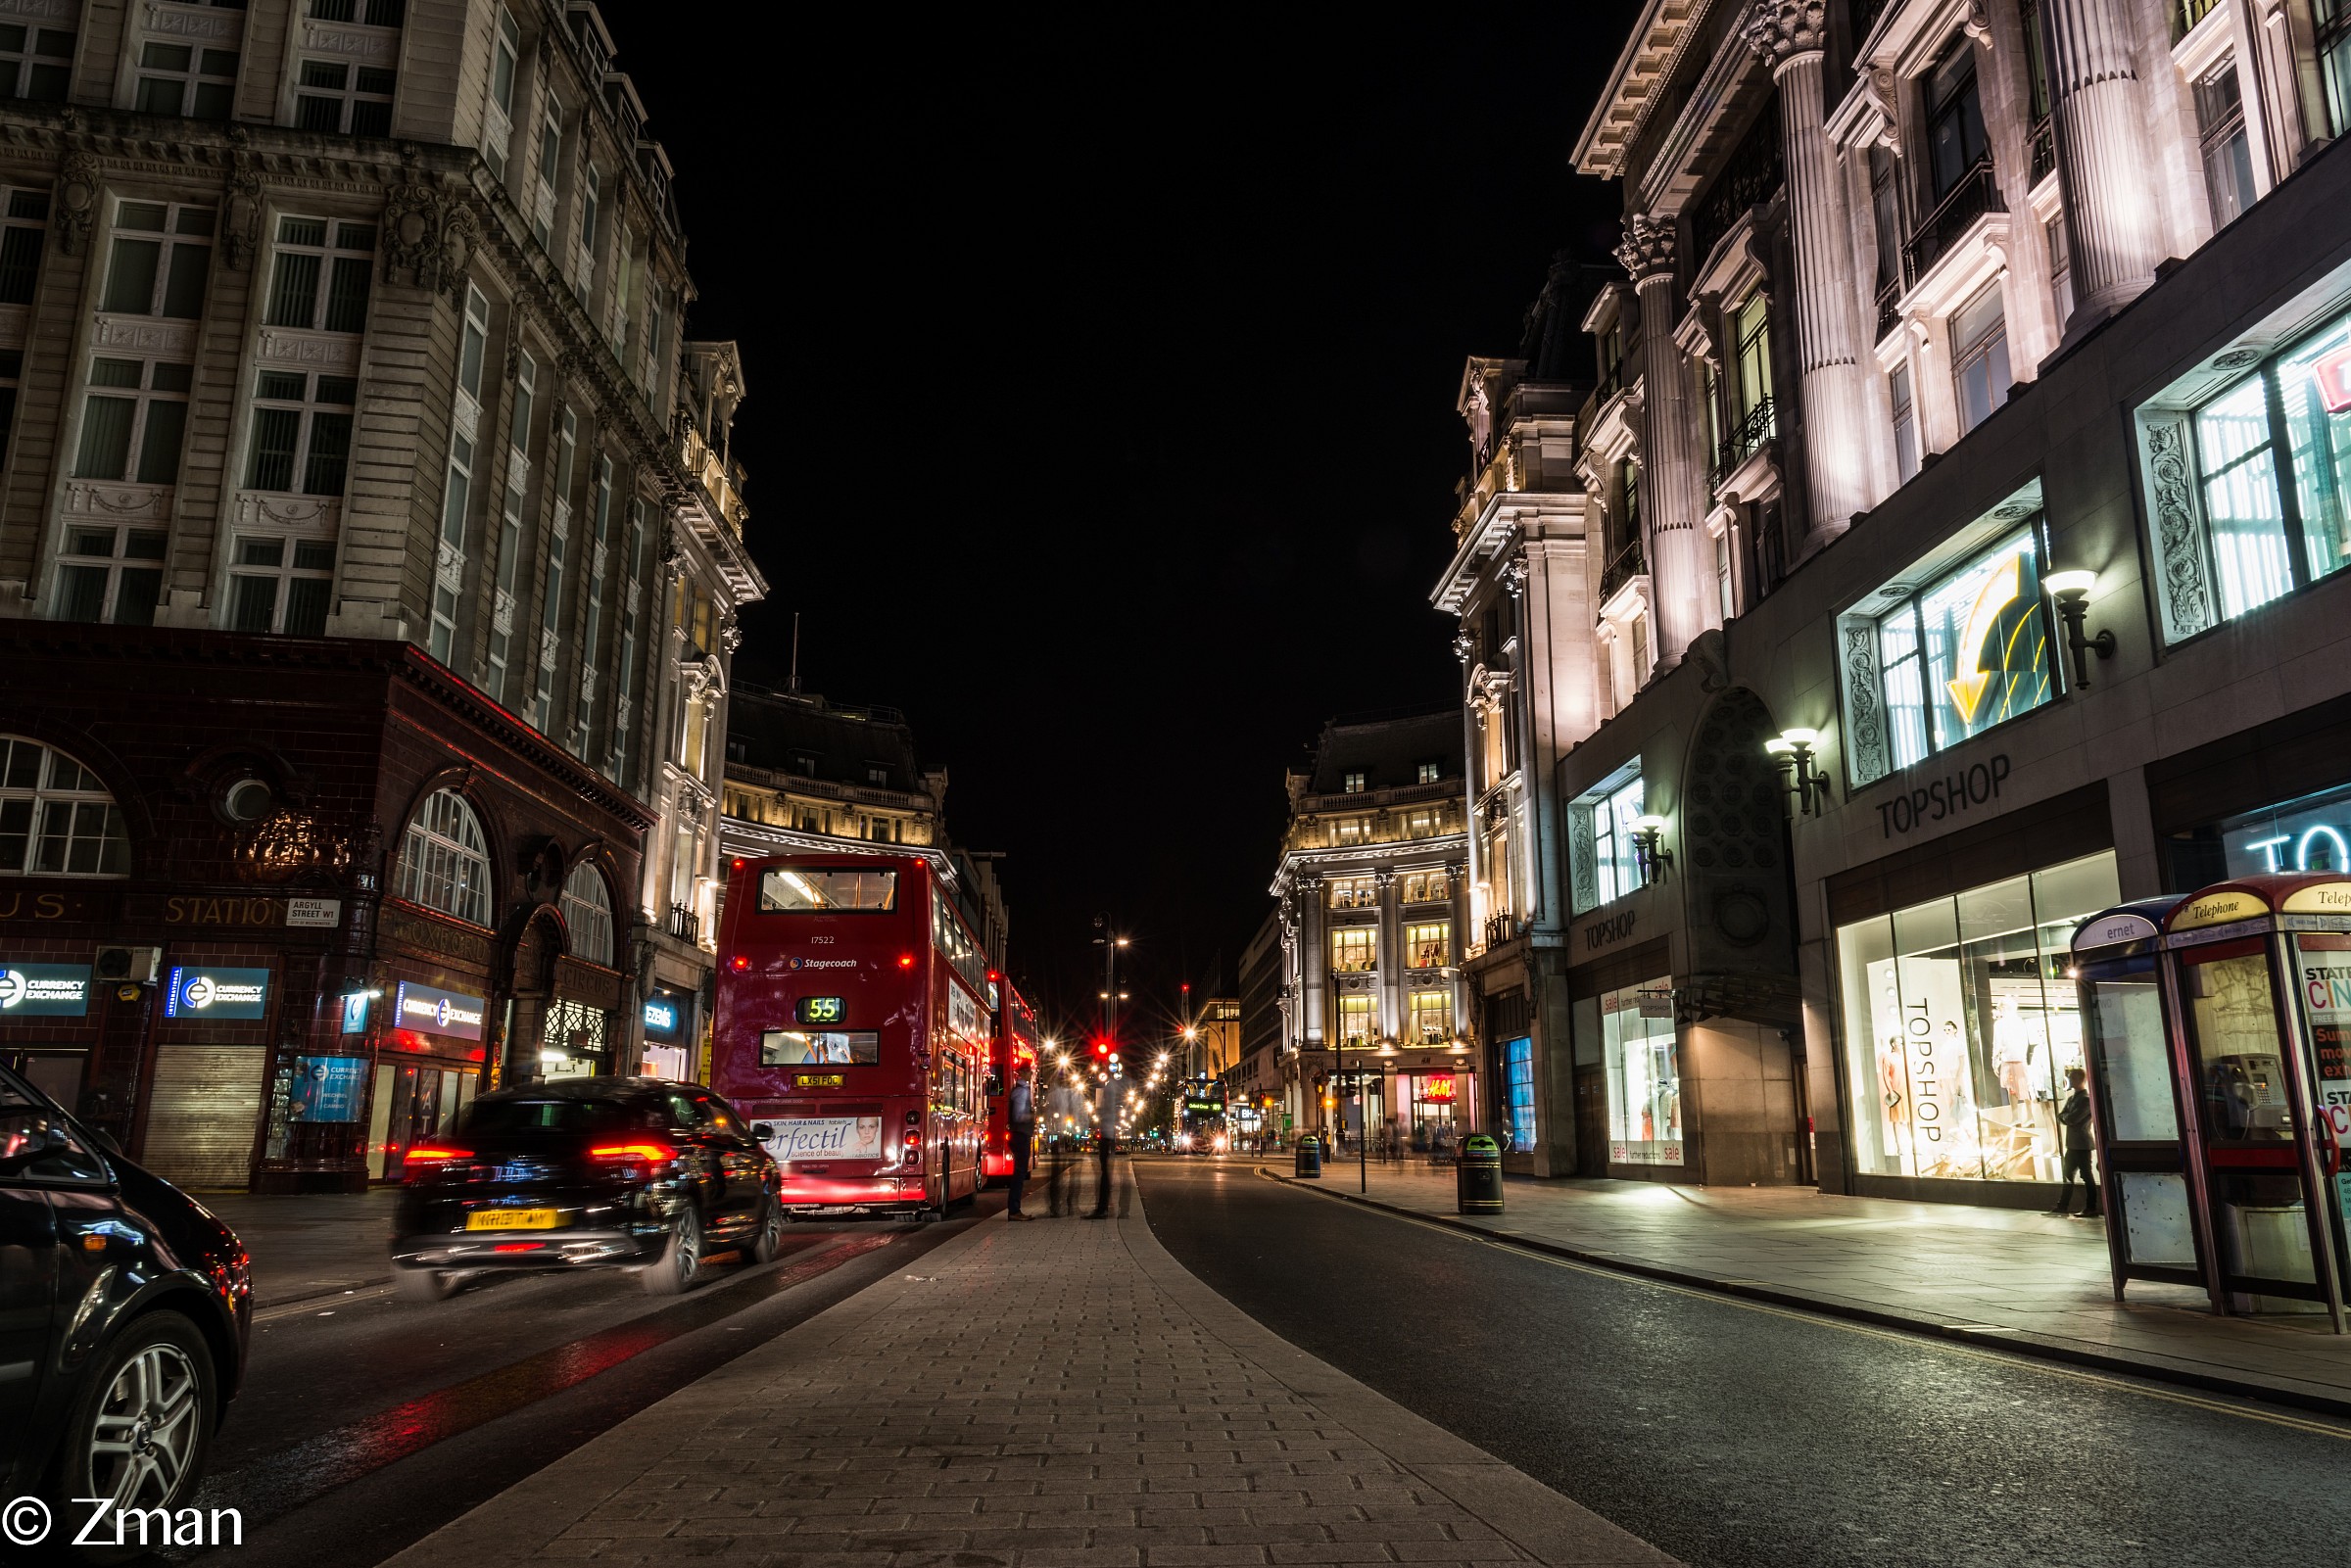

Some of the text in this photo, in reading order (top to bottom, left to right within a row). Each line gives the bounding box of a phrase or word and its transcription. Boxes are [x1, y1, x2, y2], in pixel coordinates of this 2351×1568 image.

[1875, 753, 2010, 838] TOPSHOP
[293, 901, 323, 910] ARGYLL
[2193, 900, 2239, 920] Telephone
[1584, 909, 1635, 951] TOPSHOP
[2107, 923, 2135, 939] ernet
[411, 921, 486, 960] OXFORD
[804, 959, 857, 970] Stagecoach
[27, 980, 85, 990] CURRENCY
[216, 985, 264, 994] CURRENCY
[563, 968, 611, 995] CIRCUS
[25, 990, 84, 1000] EXCHANGE
[215, 993, 262, 1002] EXCHANGE
[1605, 995, 1617, 1011] sale
[403, 999, 481, 1024] CURRENCY EXCHANGE
[809, 999, 836, 1018] 55
[2313, 1015, 2333, 1023] FREE
[2316, 1027, 2351, 1042] Sum
[1907, 997, 1941, 1142] TOPSHOP
[801, 1076, 839, 1085] LX51 FOC
[1427, 1079, 1452, 1097] H&M
[1613, 1144, 1626, 1159] sale
[1629, 1151, 1642, 1160] further
[1664, 1144, 1680, 1161] sale
